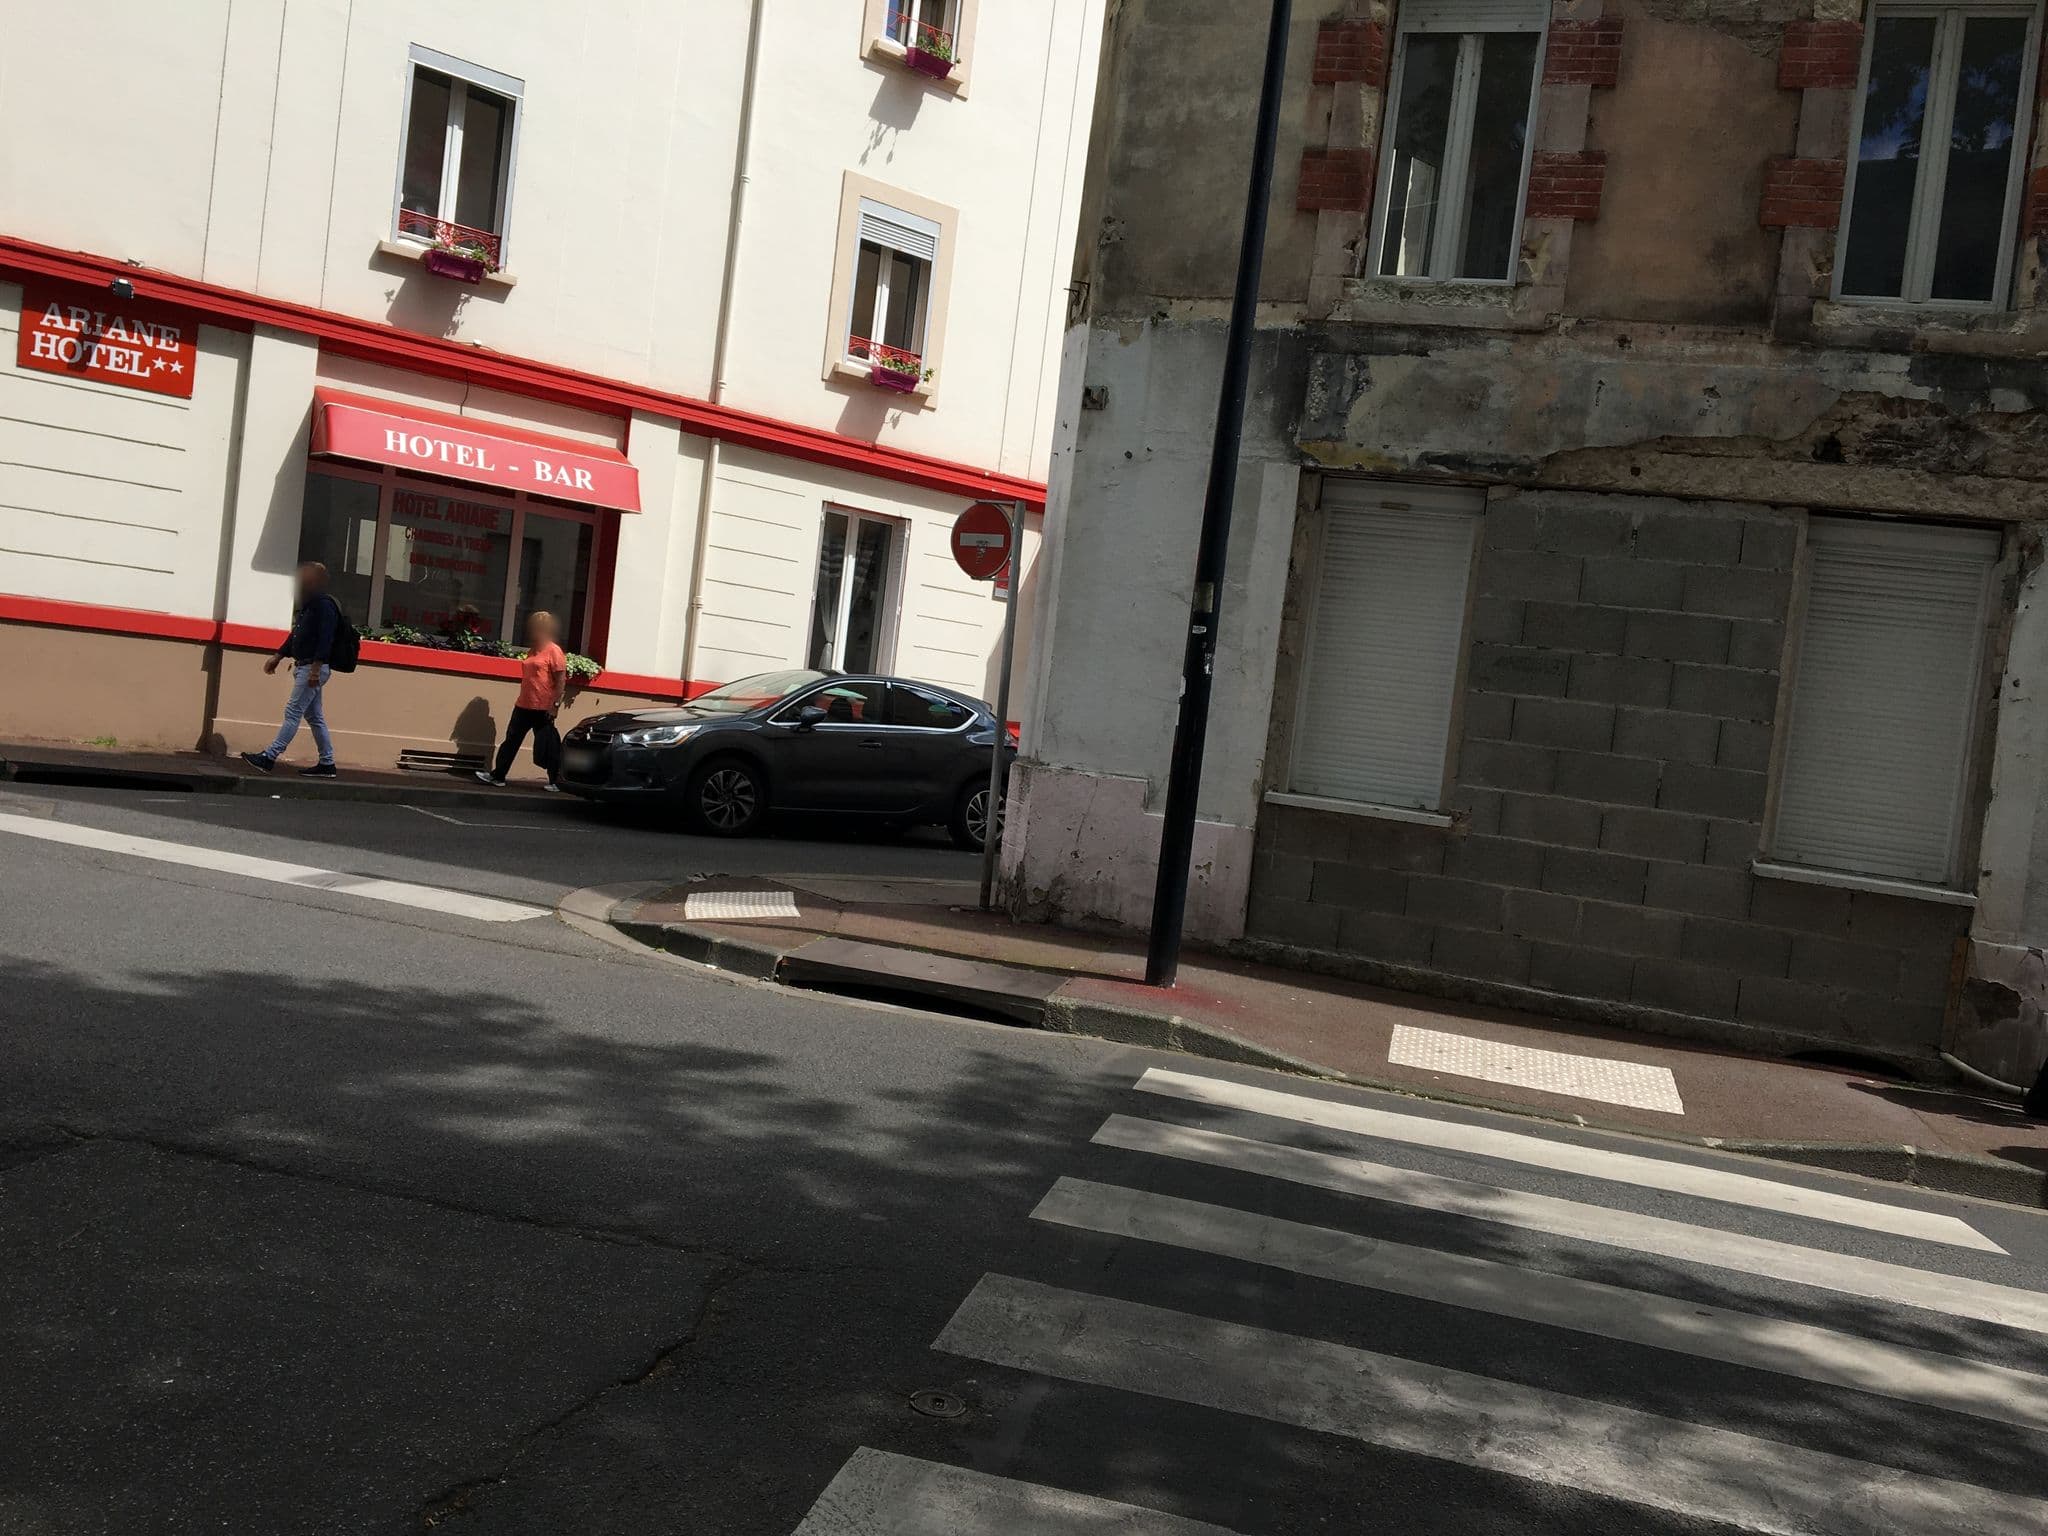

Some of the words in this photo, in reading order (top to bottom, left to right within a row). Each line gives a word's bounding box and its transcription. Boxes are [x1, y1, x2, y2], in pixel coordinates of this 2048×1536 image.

[40, 302, 181, 352] ARIANE
[30, 330, 151, 378] HOTEL
[383, 429, 496, 471] HOTEL
[533, 459, 595, 491] BAR
[392, 490, 442, 520] HOTEL
[445, 501, 499, 529] ARIANE
